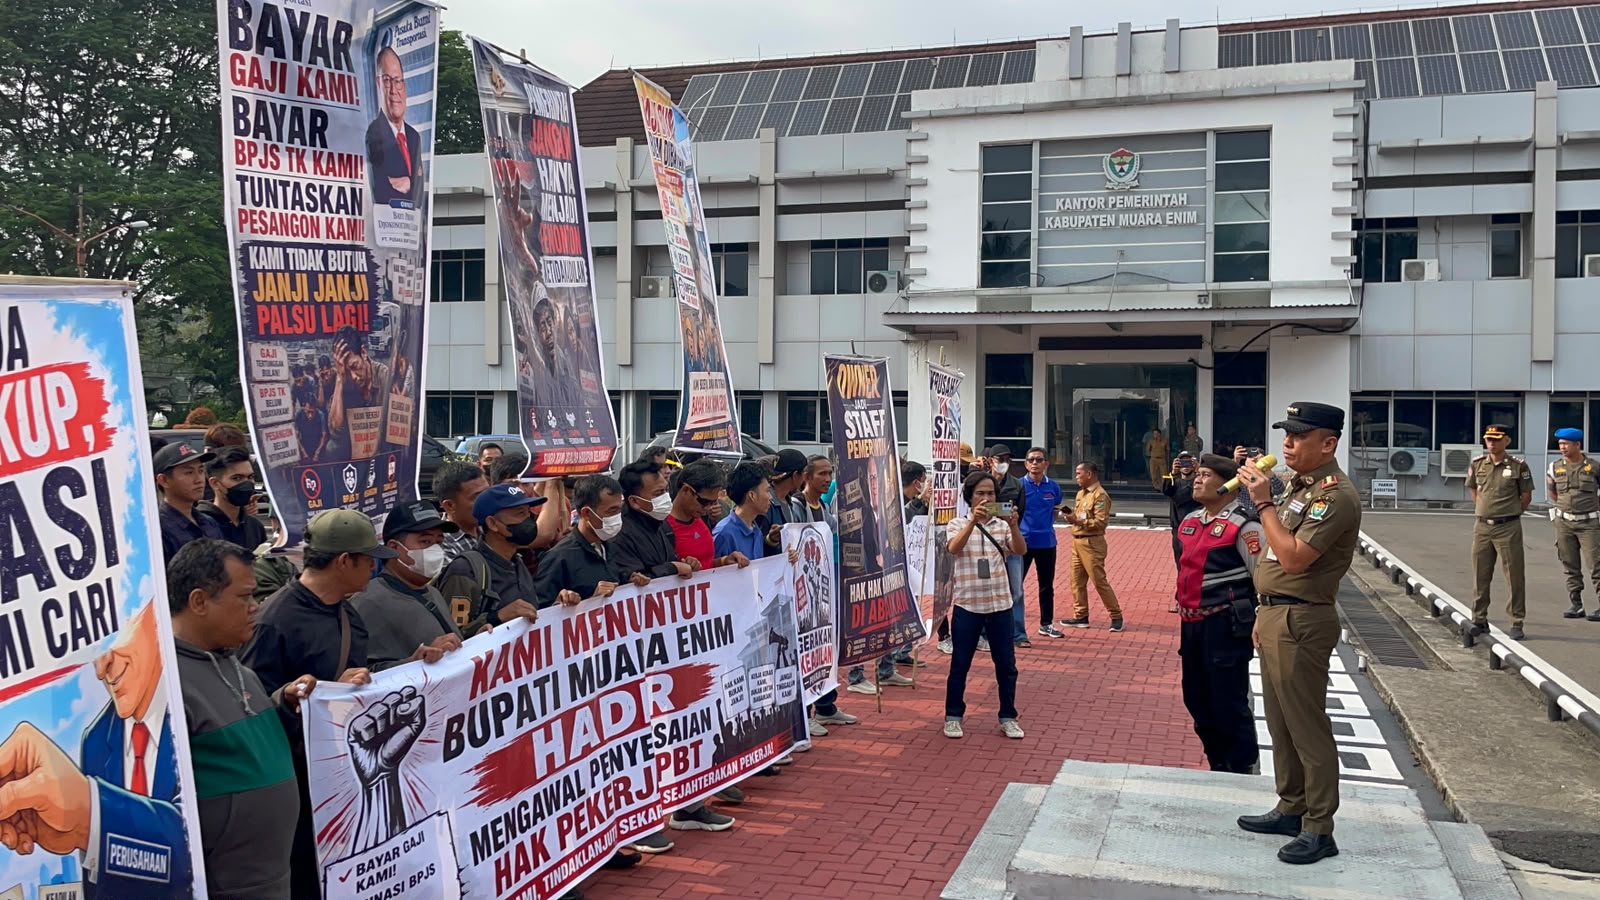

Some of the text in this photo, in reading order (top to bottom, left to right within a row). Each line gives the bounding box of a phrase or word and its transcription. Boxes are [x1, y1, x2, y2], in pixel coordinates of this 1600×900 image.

[228, 0, 355, 73] BAYAR
[230, 52, 360, 106] GAJI KAMI!
[232, 95, 328, 149] BAYAR
[528, 118, 572, 160] JANGAN
[234, 139, 364, 180] BPJS TK KAMI!
[536, 157, 576, 195] HANYA
[236, 174, 363, 216] TUNTASKAN
[540, 192, 579, 225] MENJADI
[1055, 193, 1188, 211] KANTOR PEMERINTAH
[238, 208, 365, 242] PESANGON KAMI!
[1045, 211, 1198, 229] KABUPATEN MUARA ENIM
[249, 246, 368, 272] KAMI TIDAK BUTUH
[252, 272, 308, 302] JANJI
[313, 274, 369, 302] JANJI
[257, 304, 316, 335] PALSU
[260, 348, 277, 358] GAJI
[259, 388, 276, 398] BPJS
[837, 363, 881, 399] OWNER
[844, 409, 885, 439] STAFF
[308, 500, 322, 509] GAJI
[850, 581, 866, 603] HAK
[868, 578, 882, 599] HAK
[41, 577, 119, 659] CARI
[851, 602, 865, 630] DI
[469, 582, 711, 701] KAMI MENUNTUT
[798, 627, 832, 653] GERAKAN
[800, 645, 832, 675] KEADILAN
[443, 670, 561, 763] BUPATI
[676, 613, 735, 660] ENIM
[469, 769, 586, 867] MENGAWAL
[494, 825, 551, 897] HAK
[655, 739, 703, 782] PBT
[542, 821, 618, 893] TINDAKLANJUTI
[663, 760, 739, 805] SEJAHTERAKAN
[739, 742, 775, 771] PEKERJA!
[110, 844, 168, 873] PERUSAHAAN
[356, 830, 425, 877] BAYAR GAJI
[356, 864, 397, 894] KAMI!
[409, 863, 436, 889] BPJS
